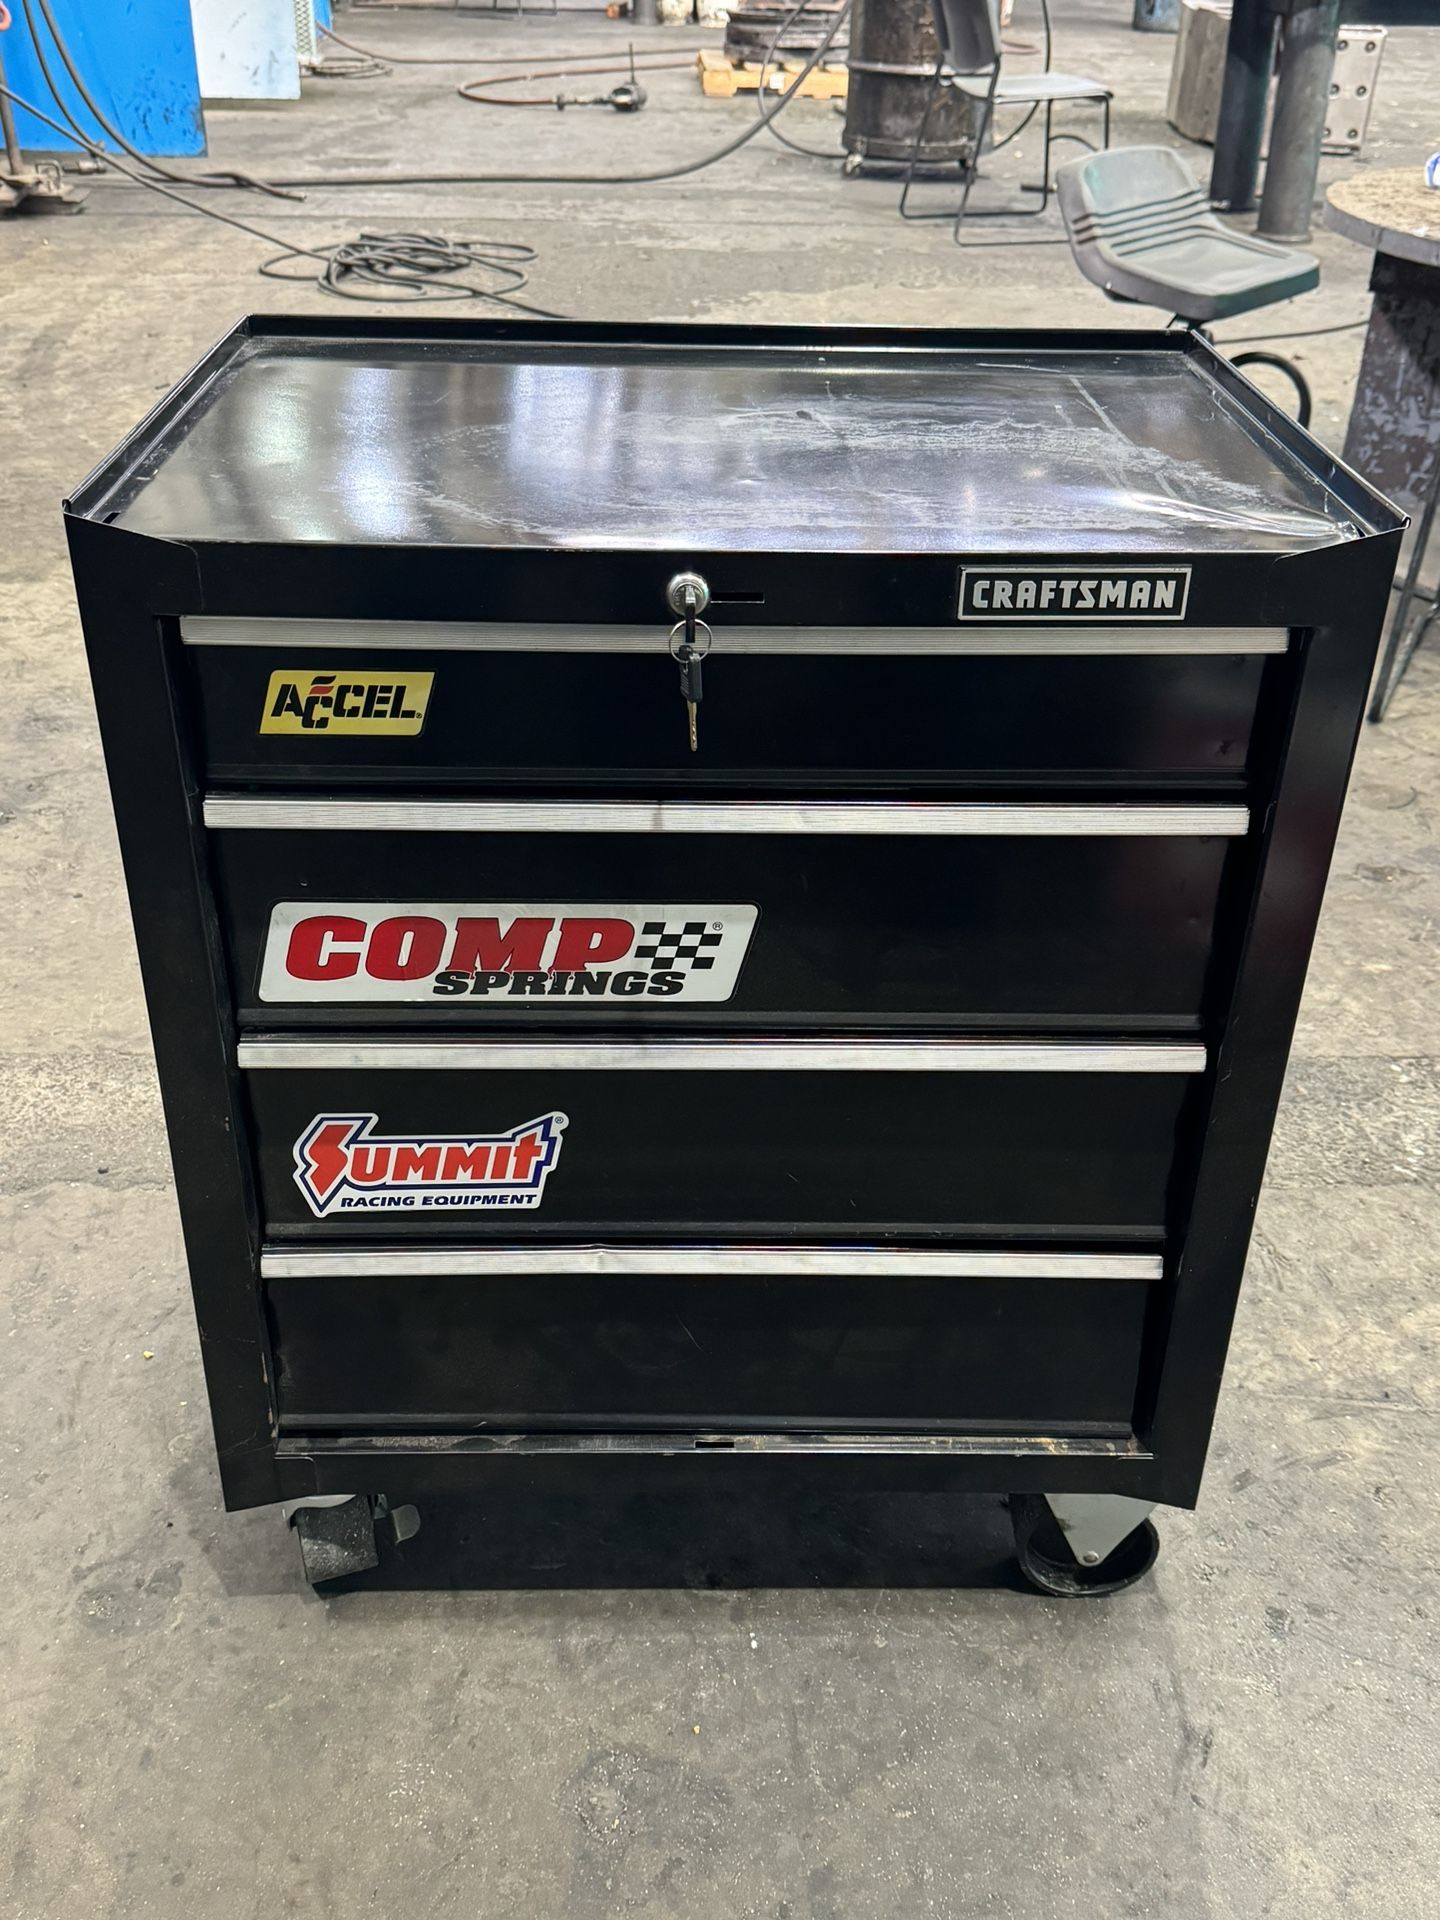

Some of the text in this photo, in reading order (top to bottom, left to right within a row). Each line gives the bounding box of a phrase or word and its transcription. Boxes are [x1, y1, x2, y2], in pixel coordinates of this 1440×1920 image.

[972, 580, 1177, 609] CRAFTSMAN
[271, 684, 417, 729] ACCEL
[285, 915, 636, 981] COMP
[432, 971, 687, 996] SPRINGS
[340, 1194, 538, 1208] RACING EQUIPMENT
